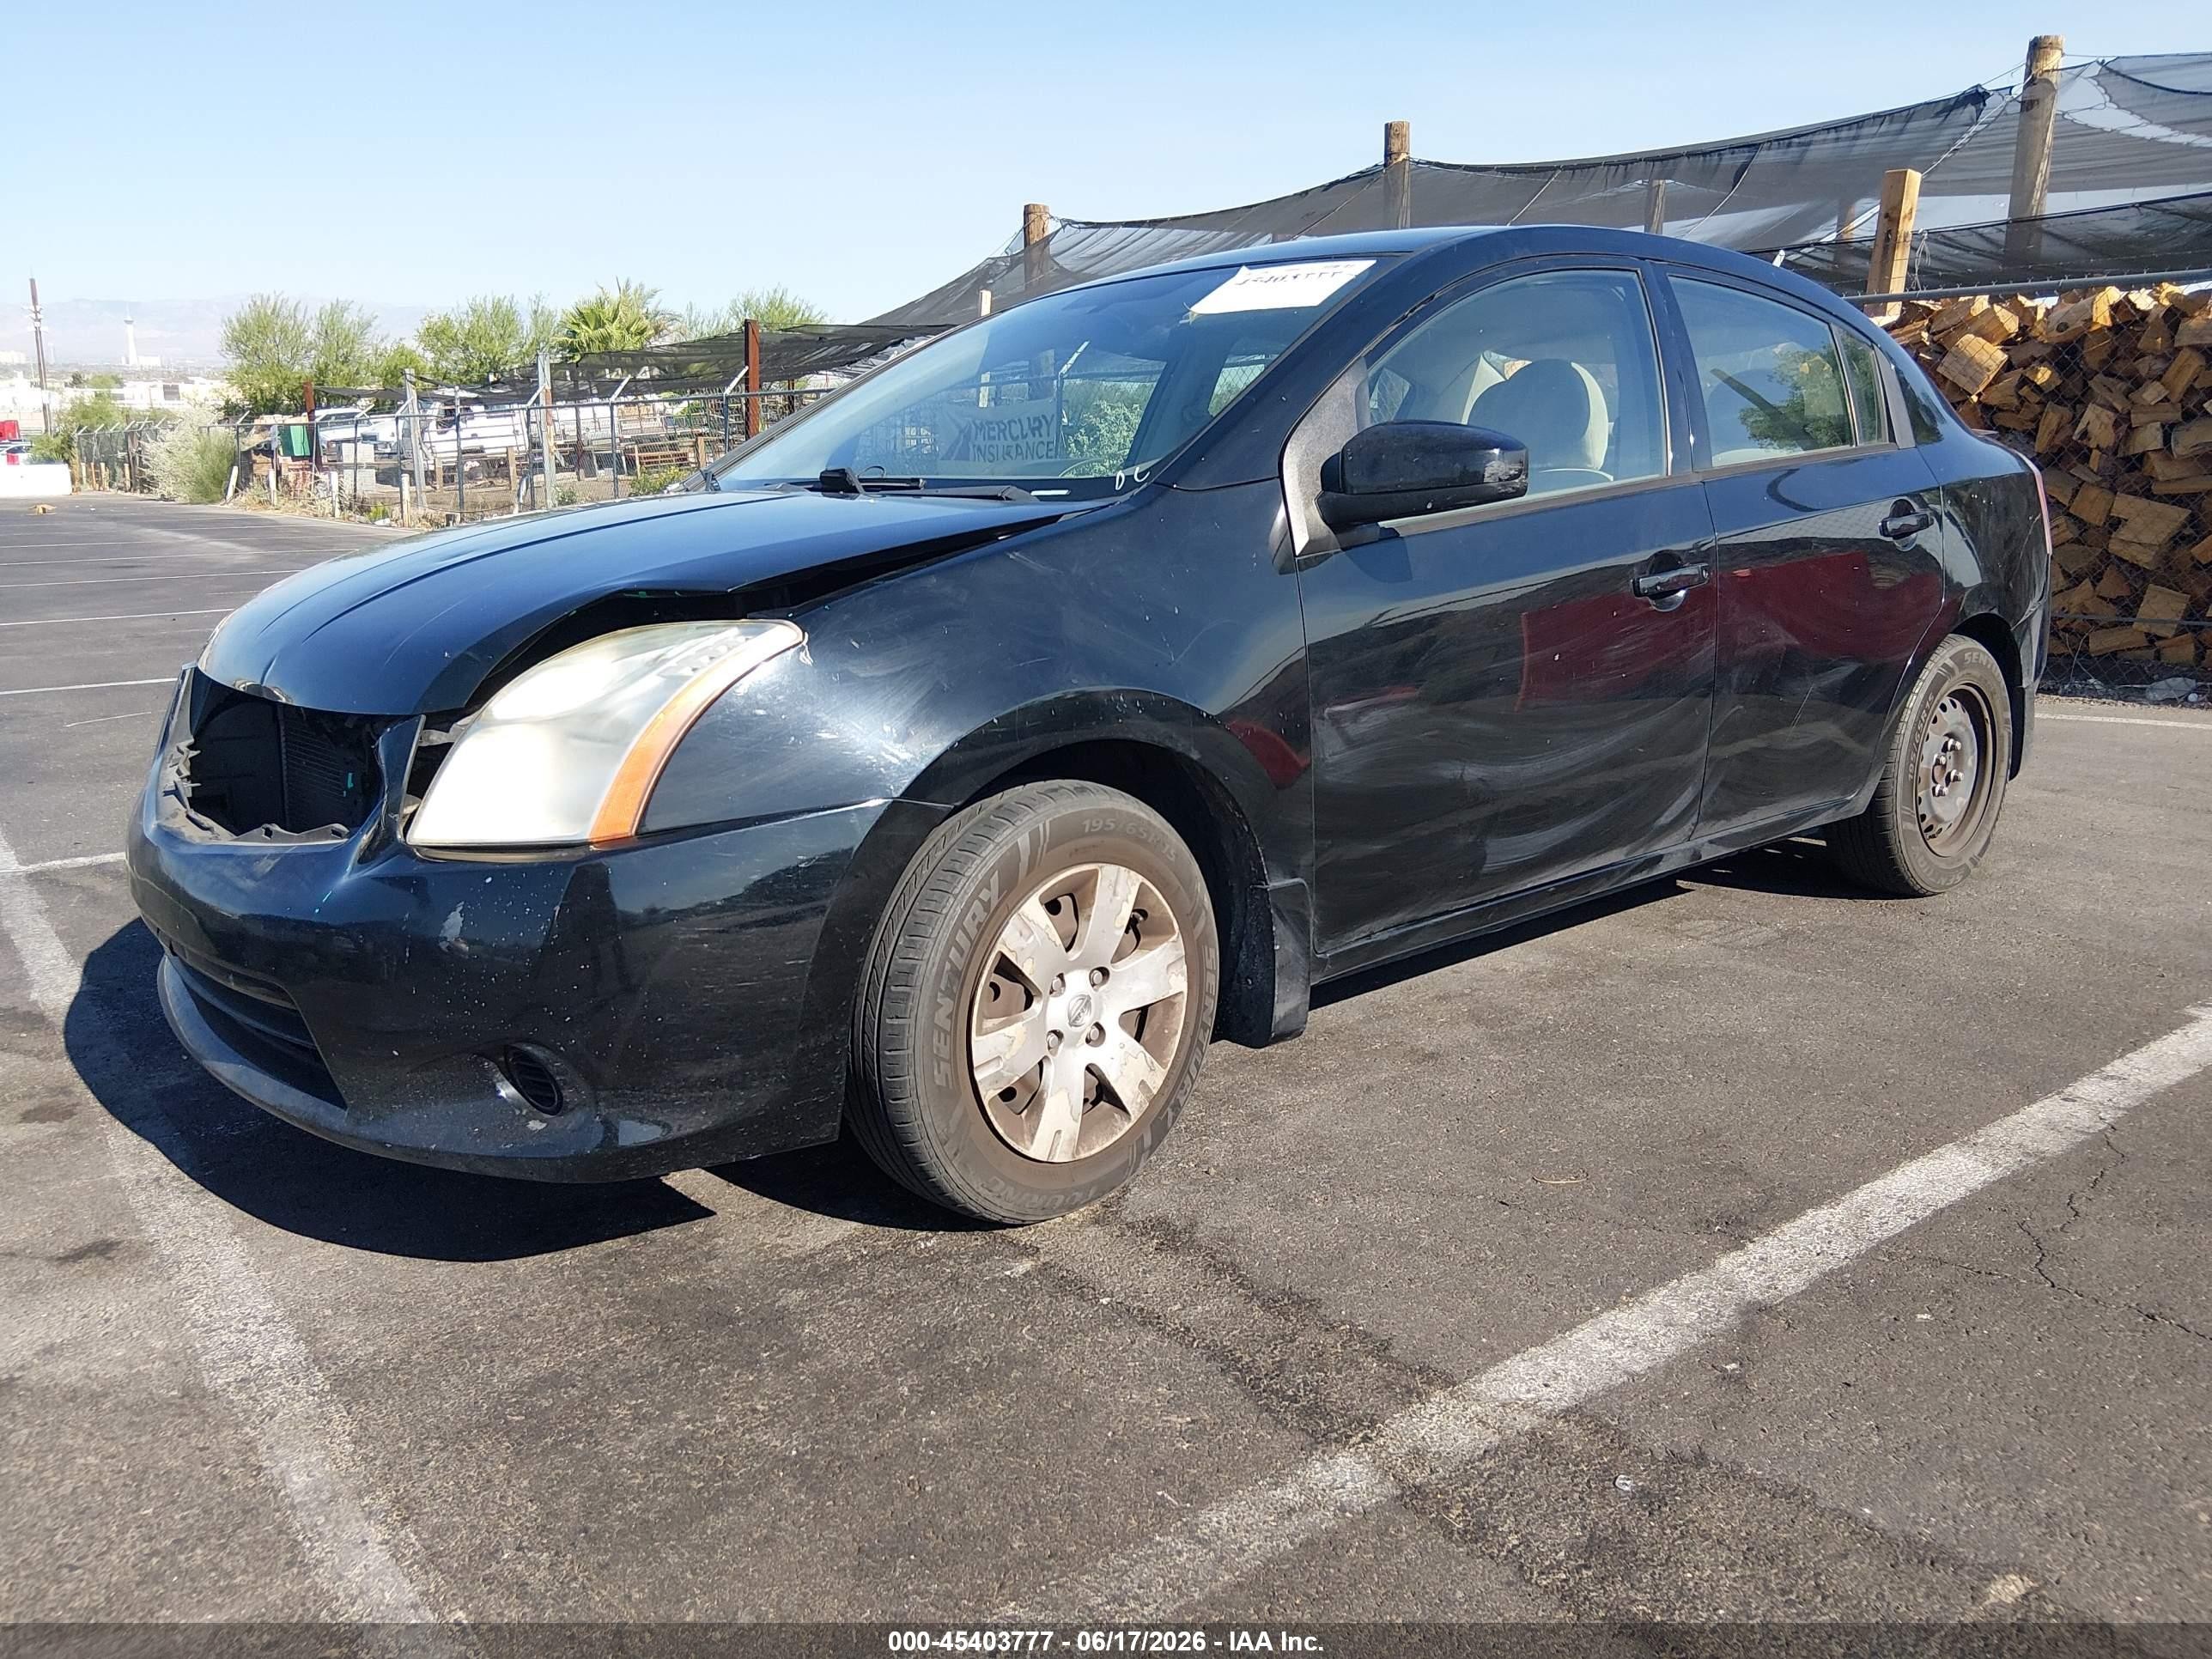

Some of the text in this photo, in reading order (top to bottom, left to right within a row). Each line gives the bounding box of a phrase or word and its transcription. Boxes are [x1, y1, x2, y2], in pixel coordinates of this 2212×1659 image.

[972, 414, 1055, 441] MERCURY
[971, 441, 1056, 462] INSURANCE
[933, 870, 1008, 1090] SENTURY
